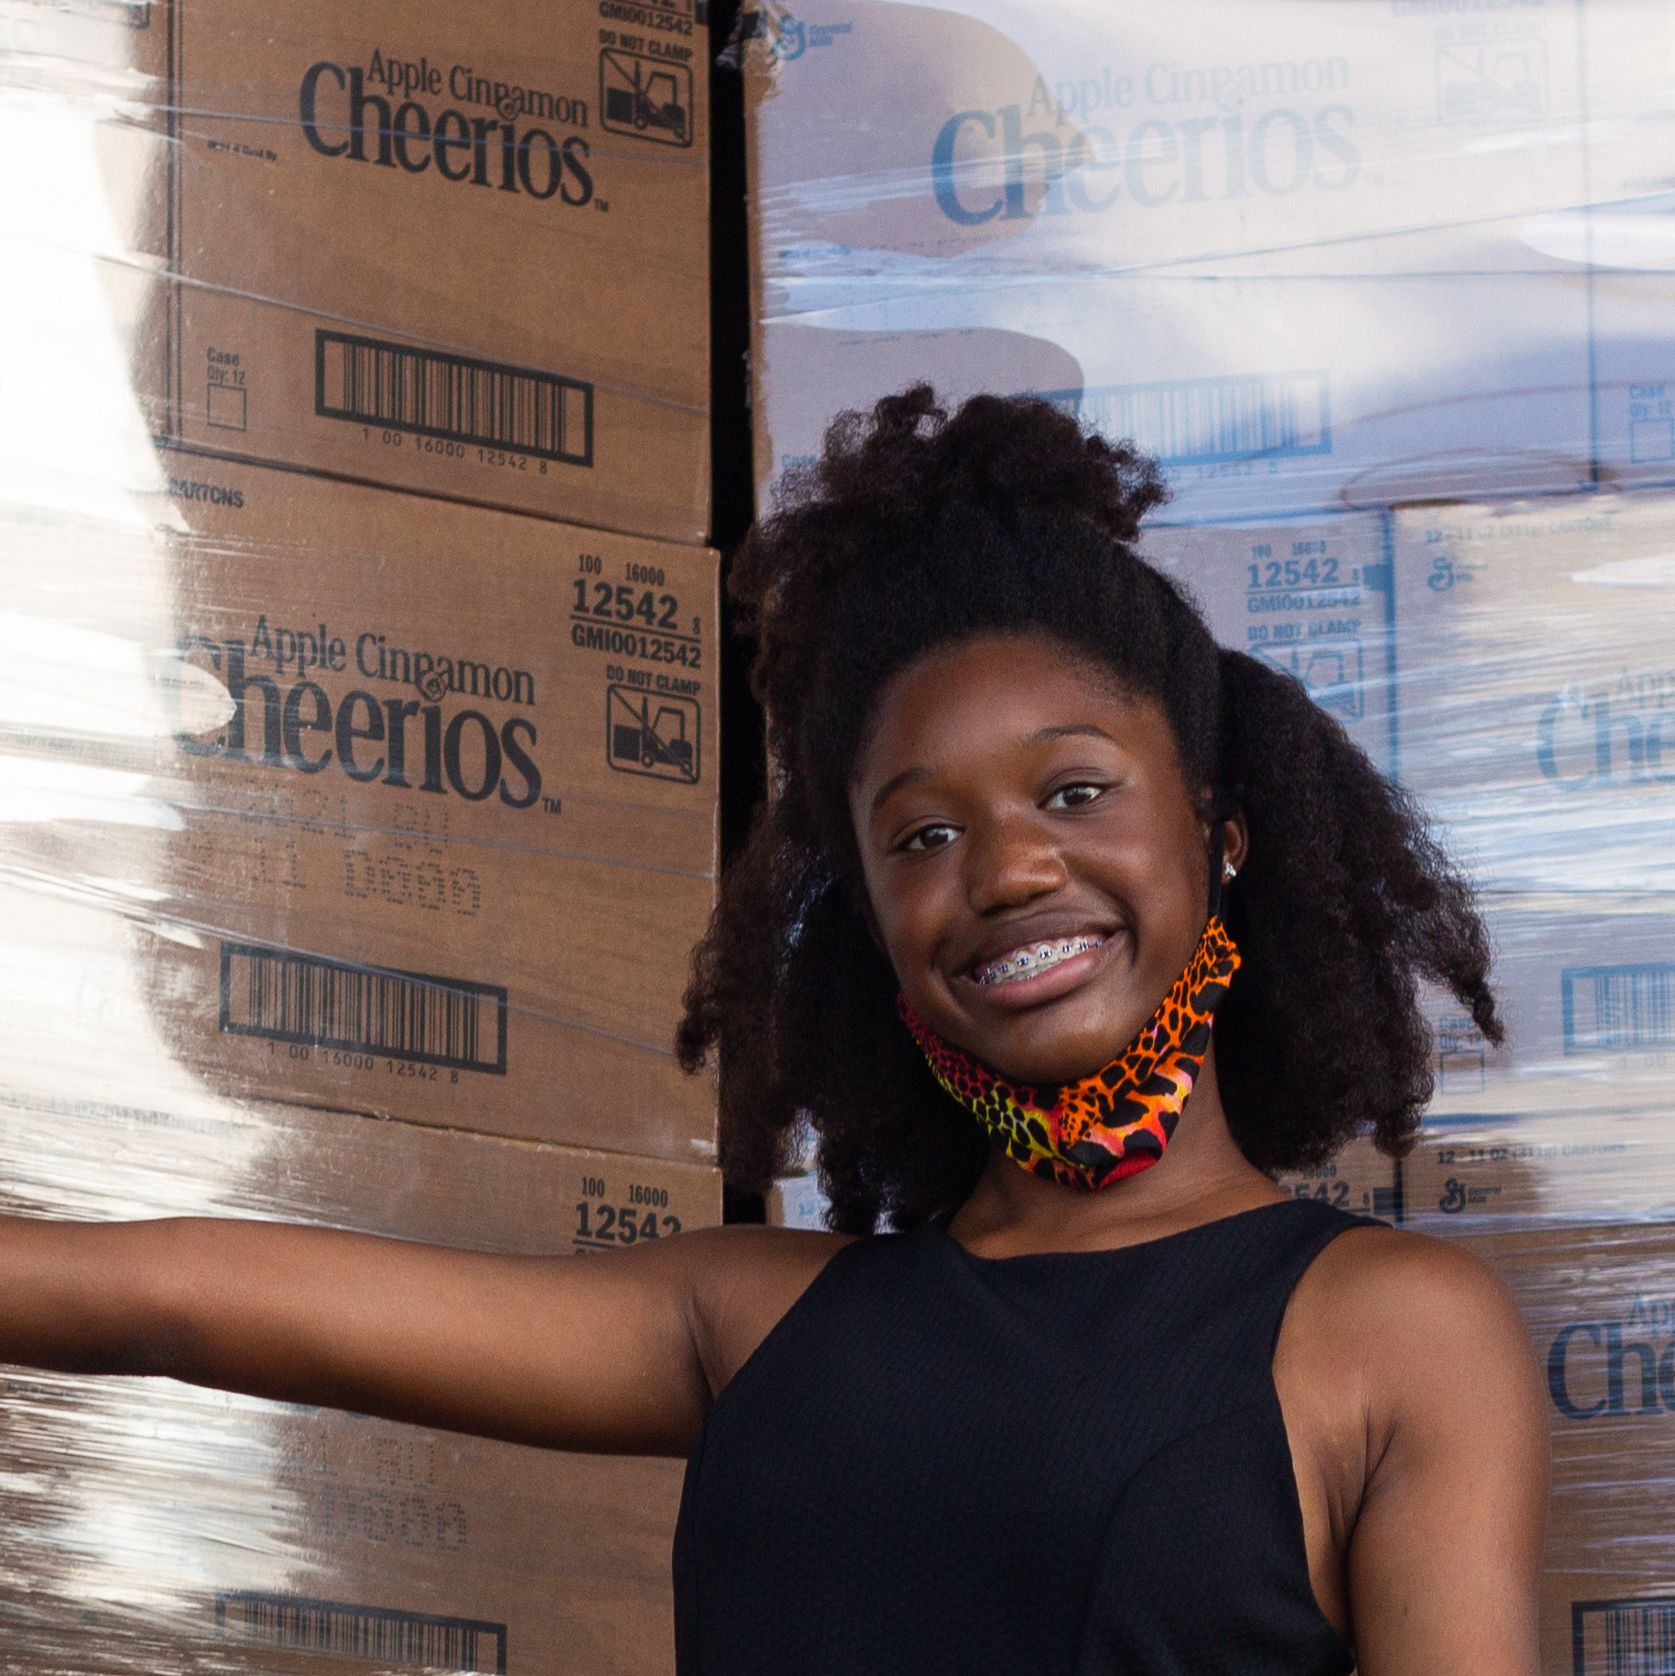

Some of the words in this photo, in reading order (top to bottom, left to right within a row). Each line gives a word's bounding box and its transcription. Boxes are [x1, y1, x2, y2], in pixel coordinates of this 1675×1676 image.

[366, 48, 442, 100] Apple
[449, 56, 589, 129] Cinnamon
[1026, 67, 1134, 131] Apple
[1143, 56, 1350, 113] Cinnamon
[298, 60, 594, 207] Cheerios
[931, 103, 1363, 226] Cheerios
[577, 553, 603, 576] 100
[624, 562, 665, 588] 16000
[1248, 557, 1339, 588] 12542
[571, 578, 679, 630] 12542
[692, 617, 701, 635] 8
[250, 614, 347, 677] Apple
[355, 632, 536, 706] Cinnamon
[570, 624, 702, 668] GMI0012542
[606, 665, 624, 682] DO
[628, 666, 652, 689] NOT
[656, 674, 701, 696] CLAMP
[581, 1176, 605, 1197] 100
[627, 1183, 669, 1207] 16000
[573, 1202, 682, 1245] 12542
